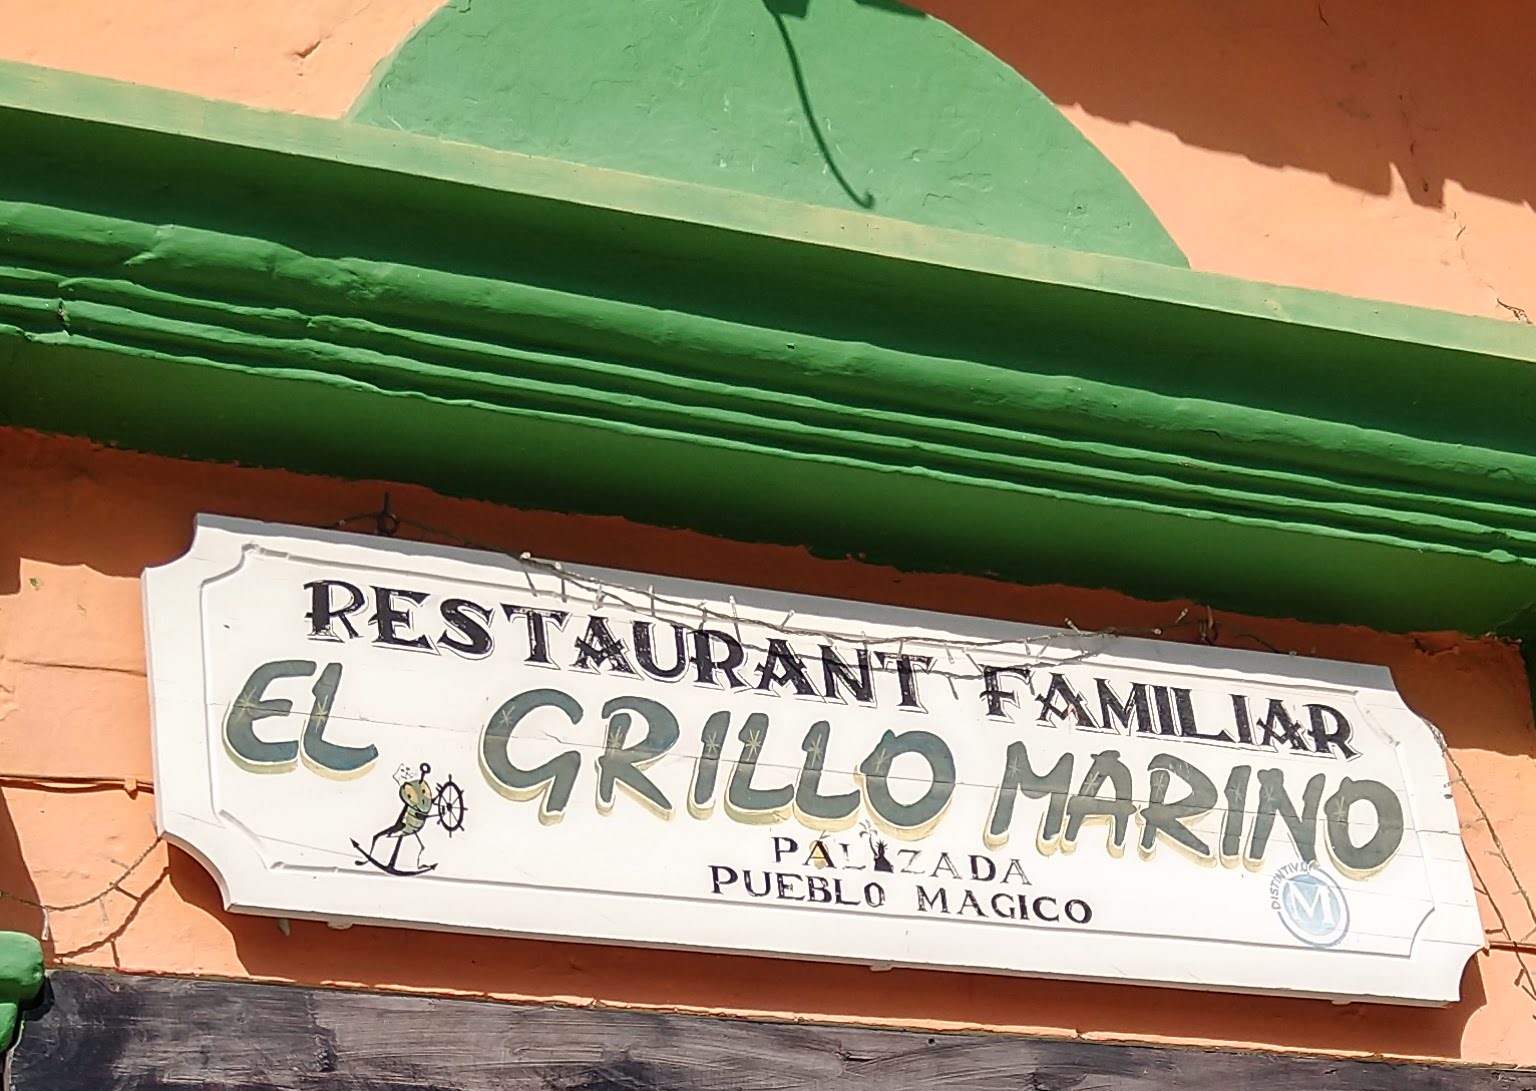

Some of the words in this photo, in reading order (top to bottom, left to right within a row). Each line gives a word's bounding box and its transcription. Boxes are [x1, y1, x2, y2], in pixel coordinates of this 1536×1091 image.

[304, 579, 932, 711] RESTAURANT
[981, 664, 1360, 759] FAMILIAR
[224, 659, 379, 776] EL
[478, 688, 956, 836] GRILLO
[985, 741, 1403, 876] MARINO
[708, 864, 886, 908] PUEBLO
[917, 884, 1093, 925] MAGICO
